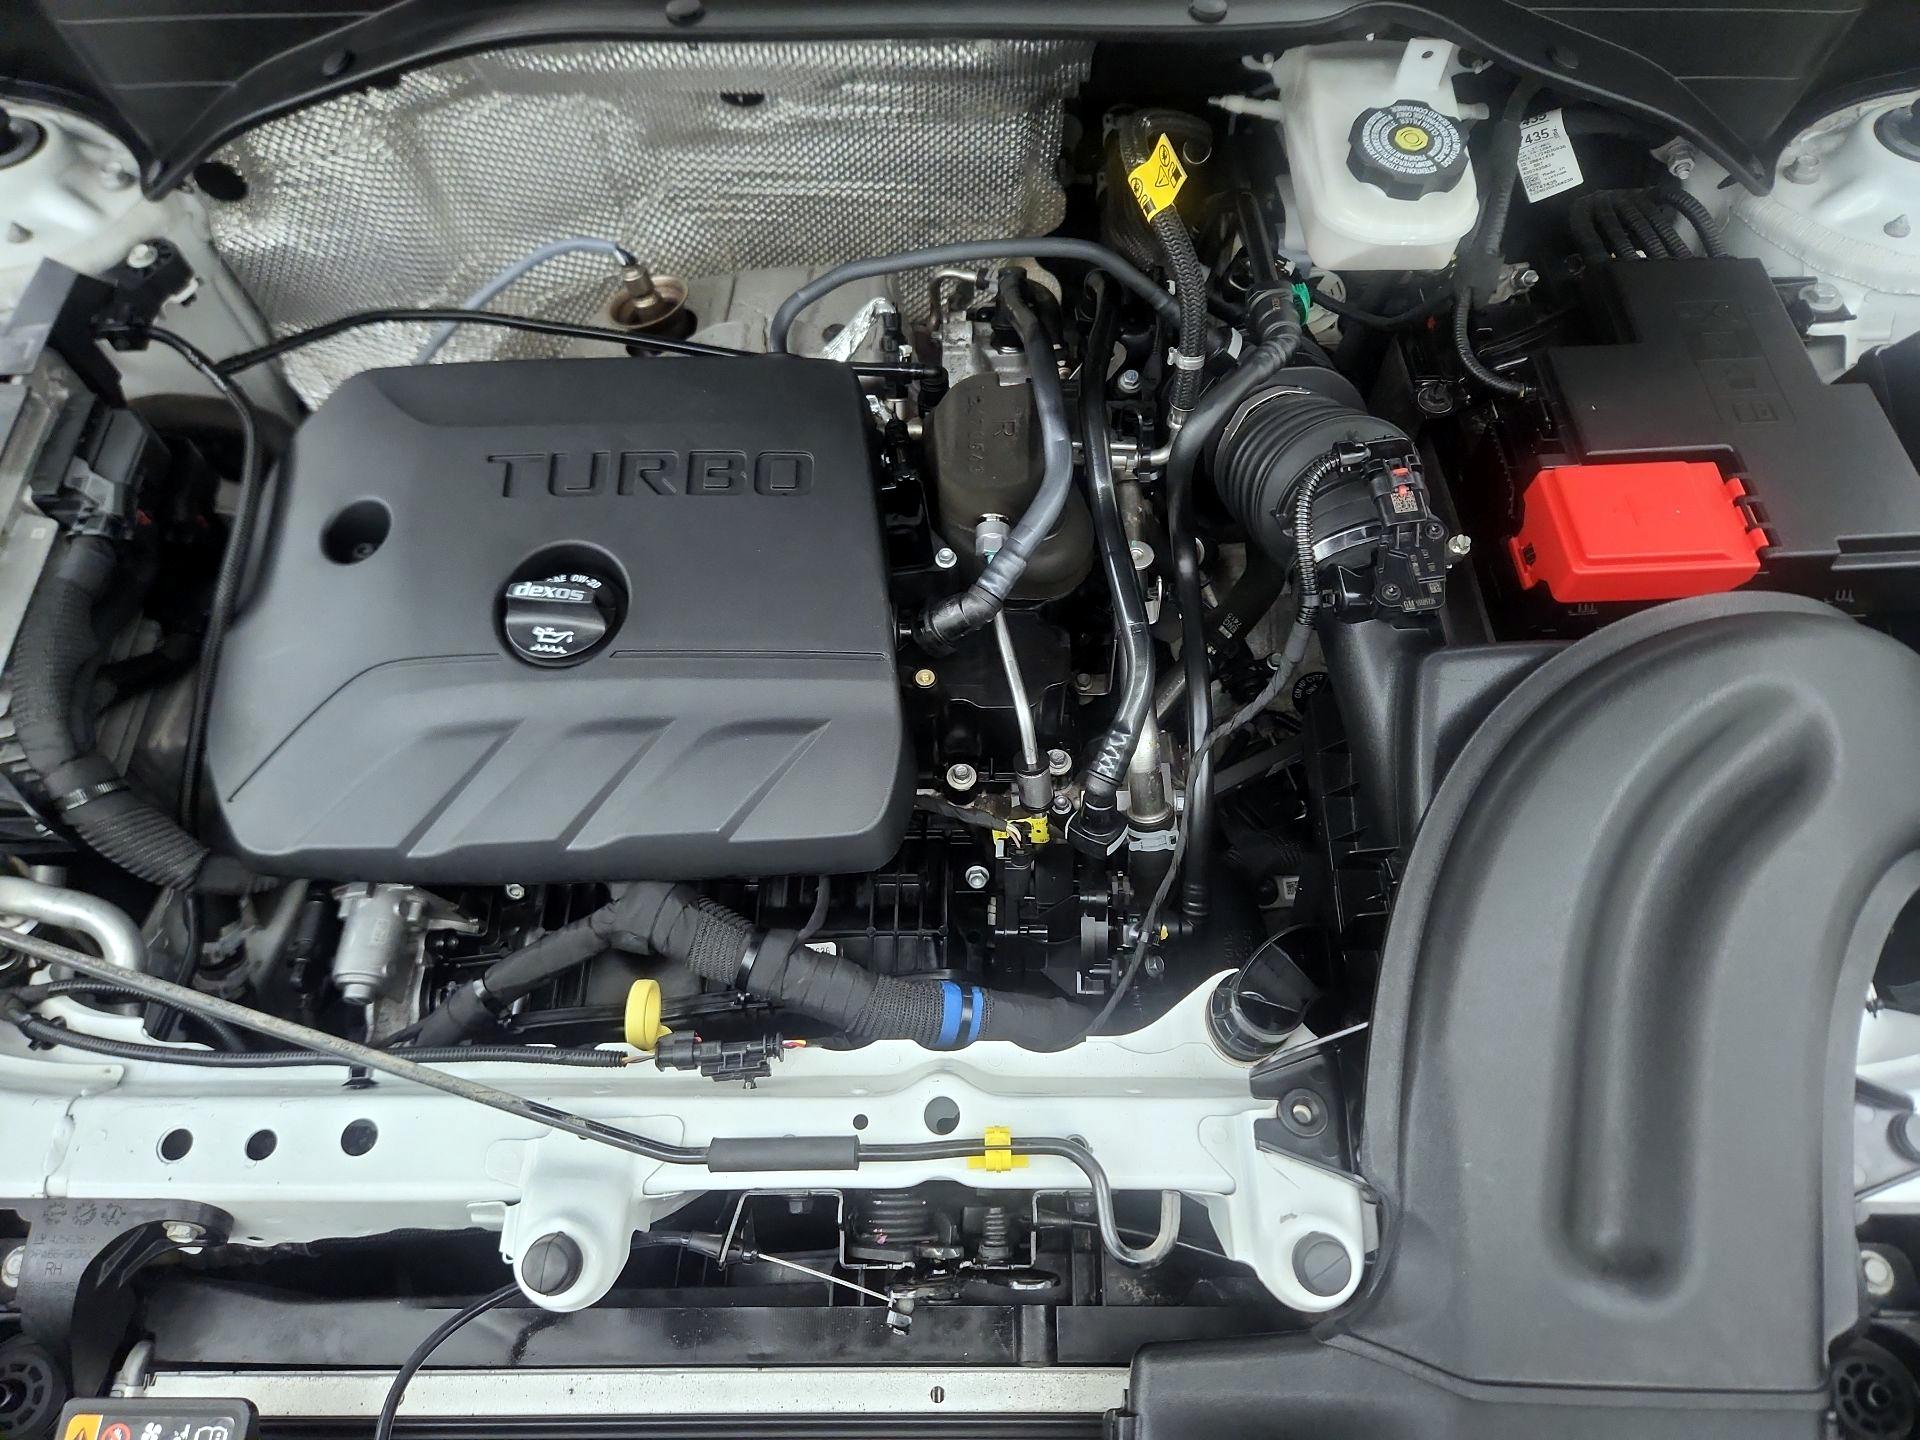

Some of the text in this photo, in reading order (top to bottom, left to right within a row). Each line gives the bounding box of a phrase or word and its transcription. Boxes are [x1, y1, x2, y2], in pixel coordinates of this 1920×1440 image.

[486, 450, 815, 497] TURBO
[570, 574, 602, 589] 0W-20
[512, 581, 587, 601] dexos
[45, 1261, 63, 1276] RH
